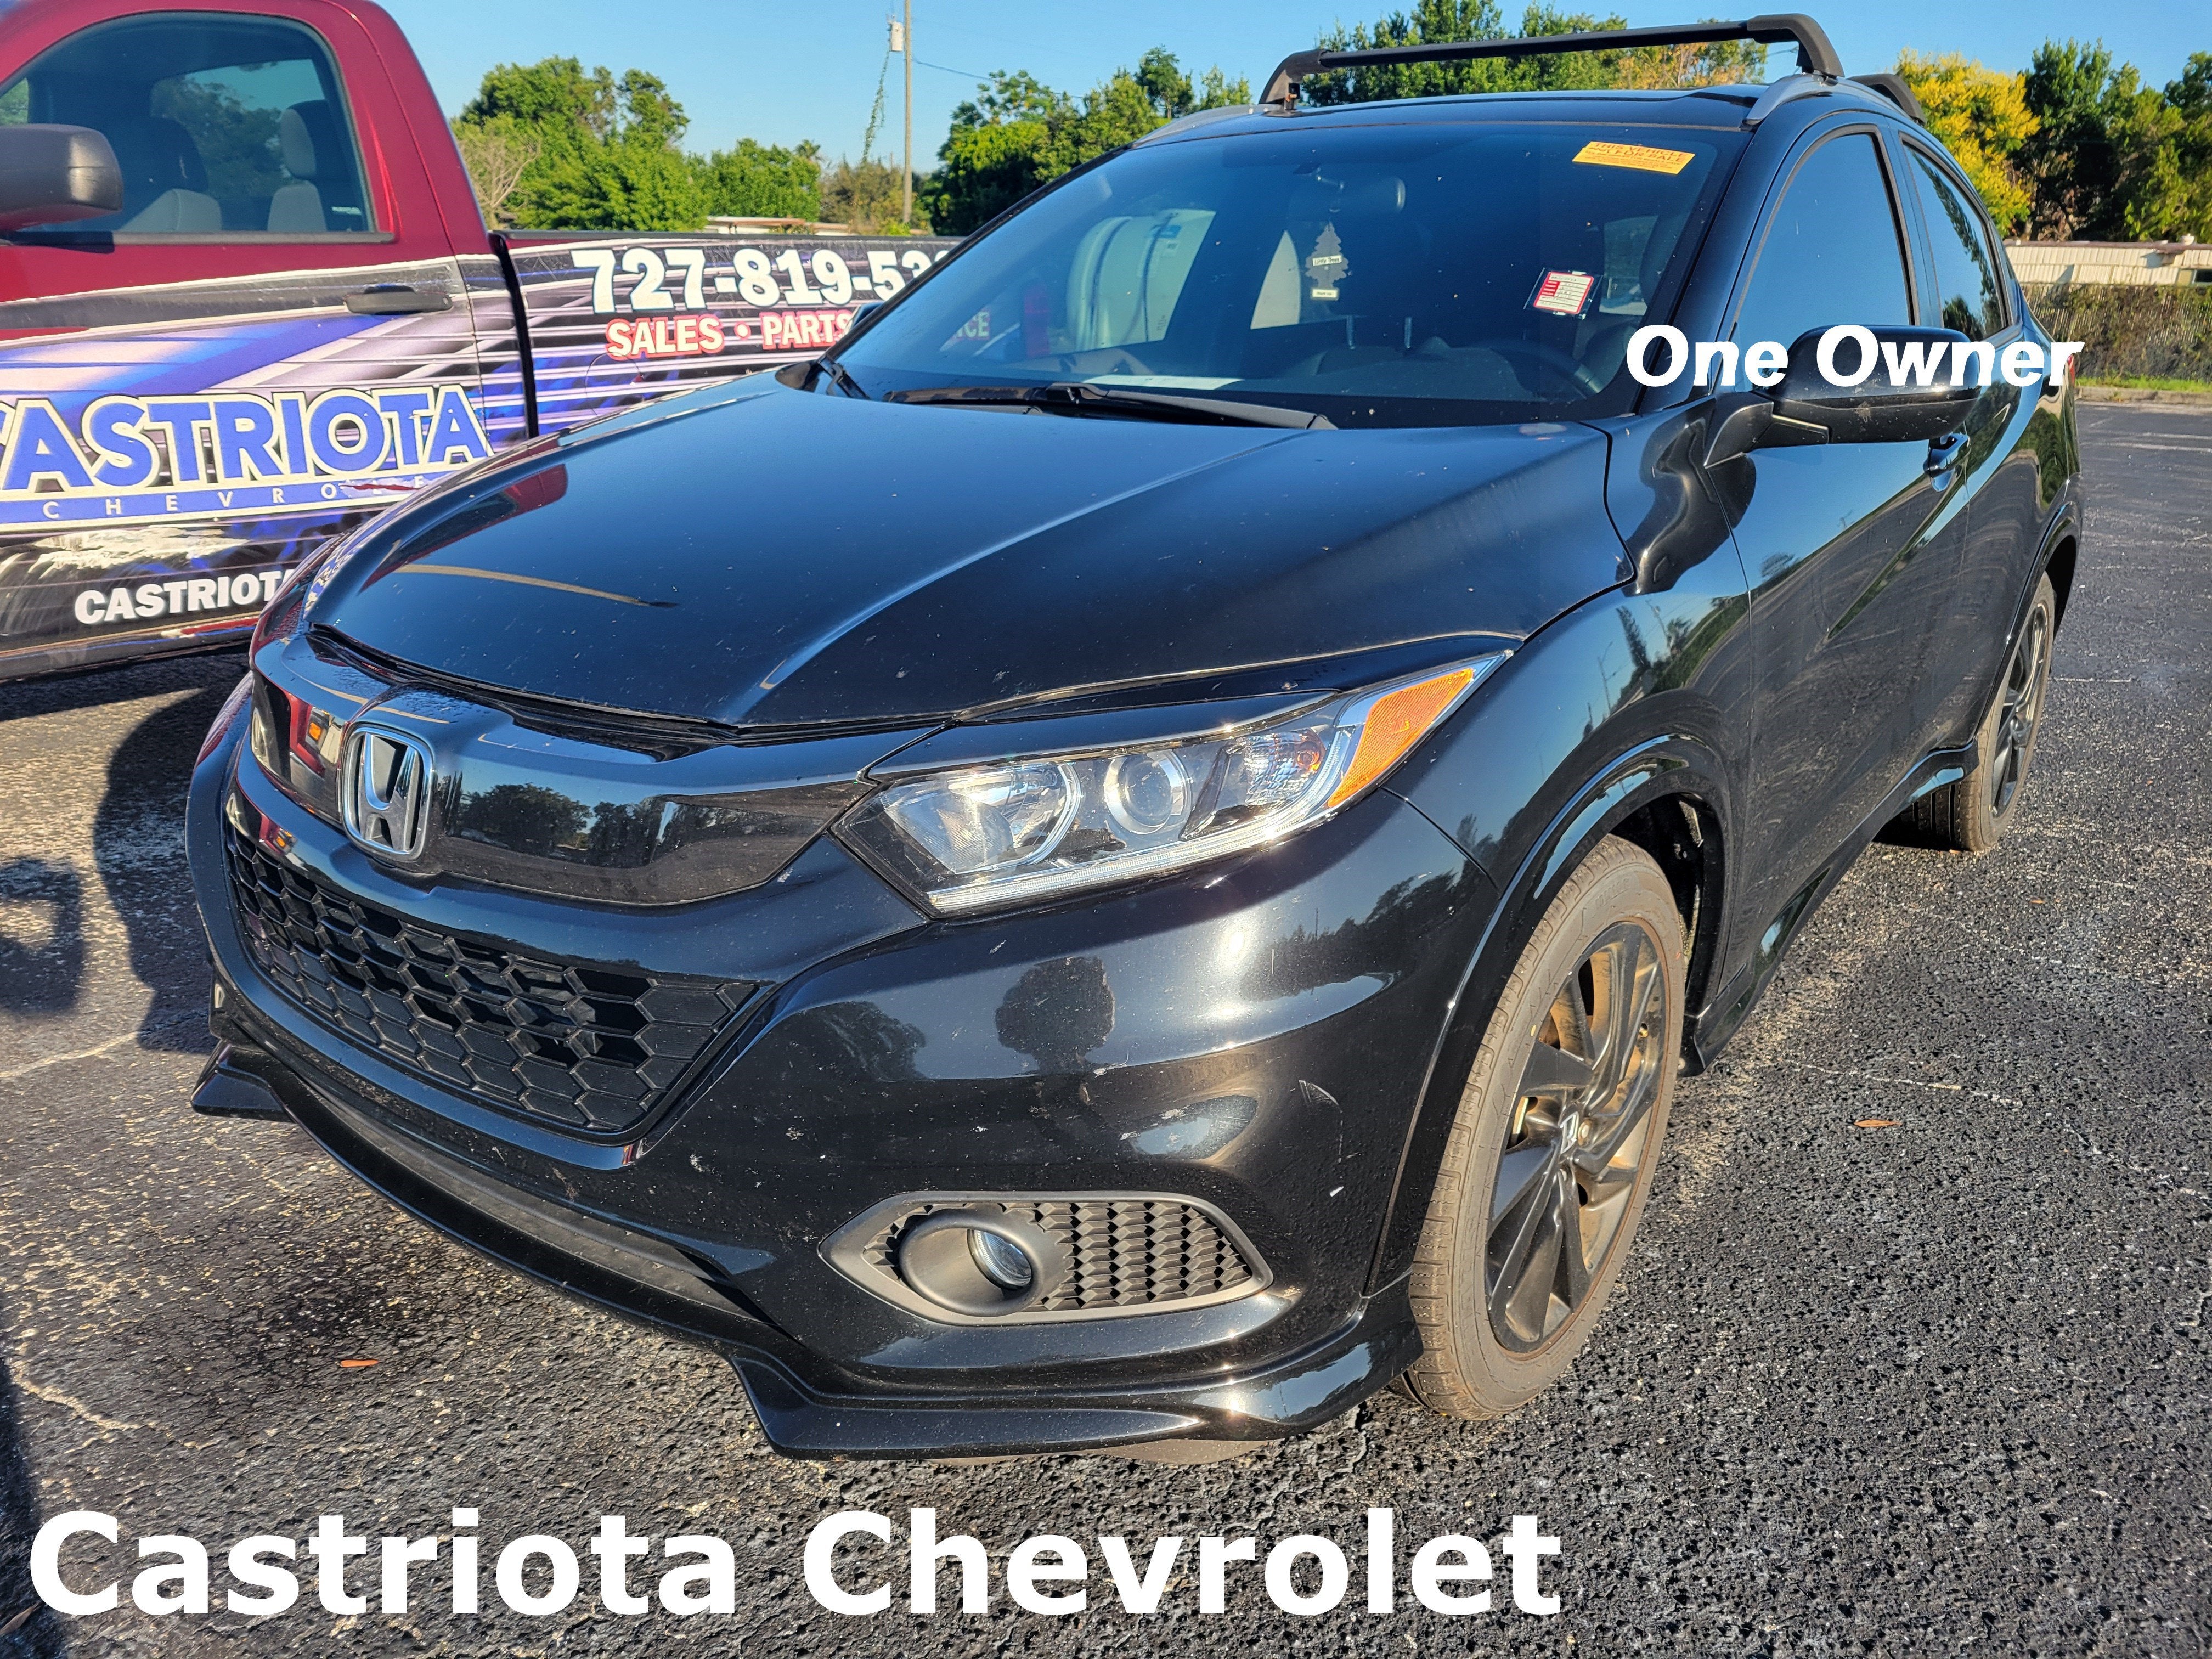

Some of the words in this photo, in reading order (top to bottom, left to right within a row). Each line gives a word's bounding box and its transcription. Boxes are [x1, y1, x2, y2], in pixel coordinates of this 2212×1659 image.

[1629, 146, 1689, 157] VEHICLE
[1647, 154, 1686, 163] SALE
[606, 316, 724, 358] SALES
[0, 387, 490, 490] ASTRIOTA
[75, 568, 294, 624] CASTRIOT
